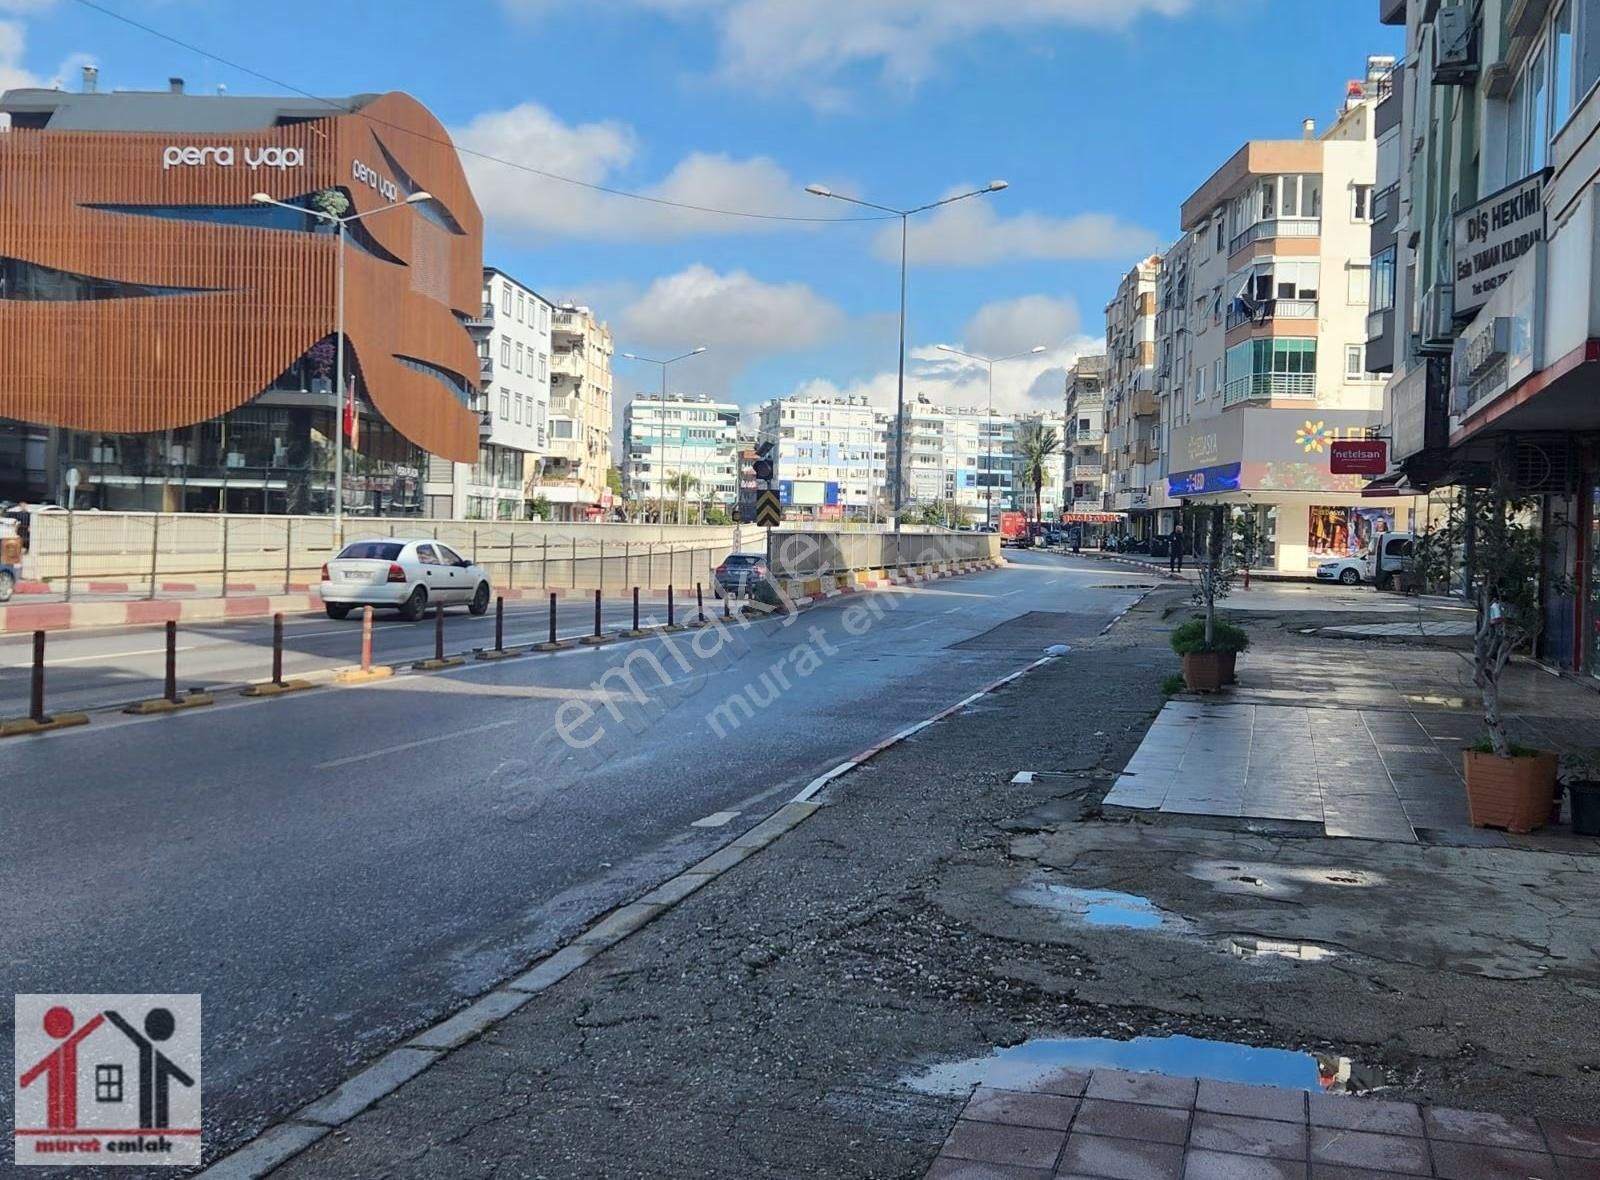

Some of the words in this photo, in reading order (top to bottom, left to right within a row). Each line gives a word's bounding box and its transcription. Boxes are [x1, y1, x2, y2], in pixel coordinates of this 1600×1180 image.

[163, 146, 234, 170] pera
[352, 159, 378, 188] pera
[1467, 209, 1488, 243] DİŞ
[1492, 180, 1540, 231] HEKİMİ
